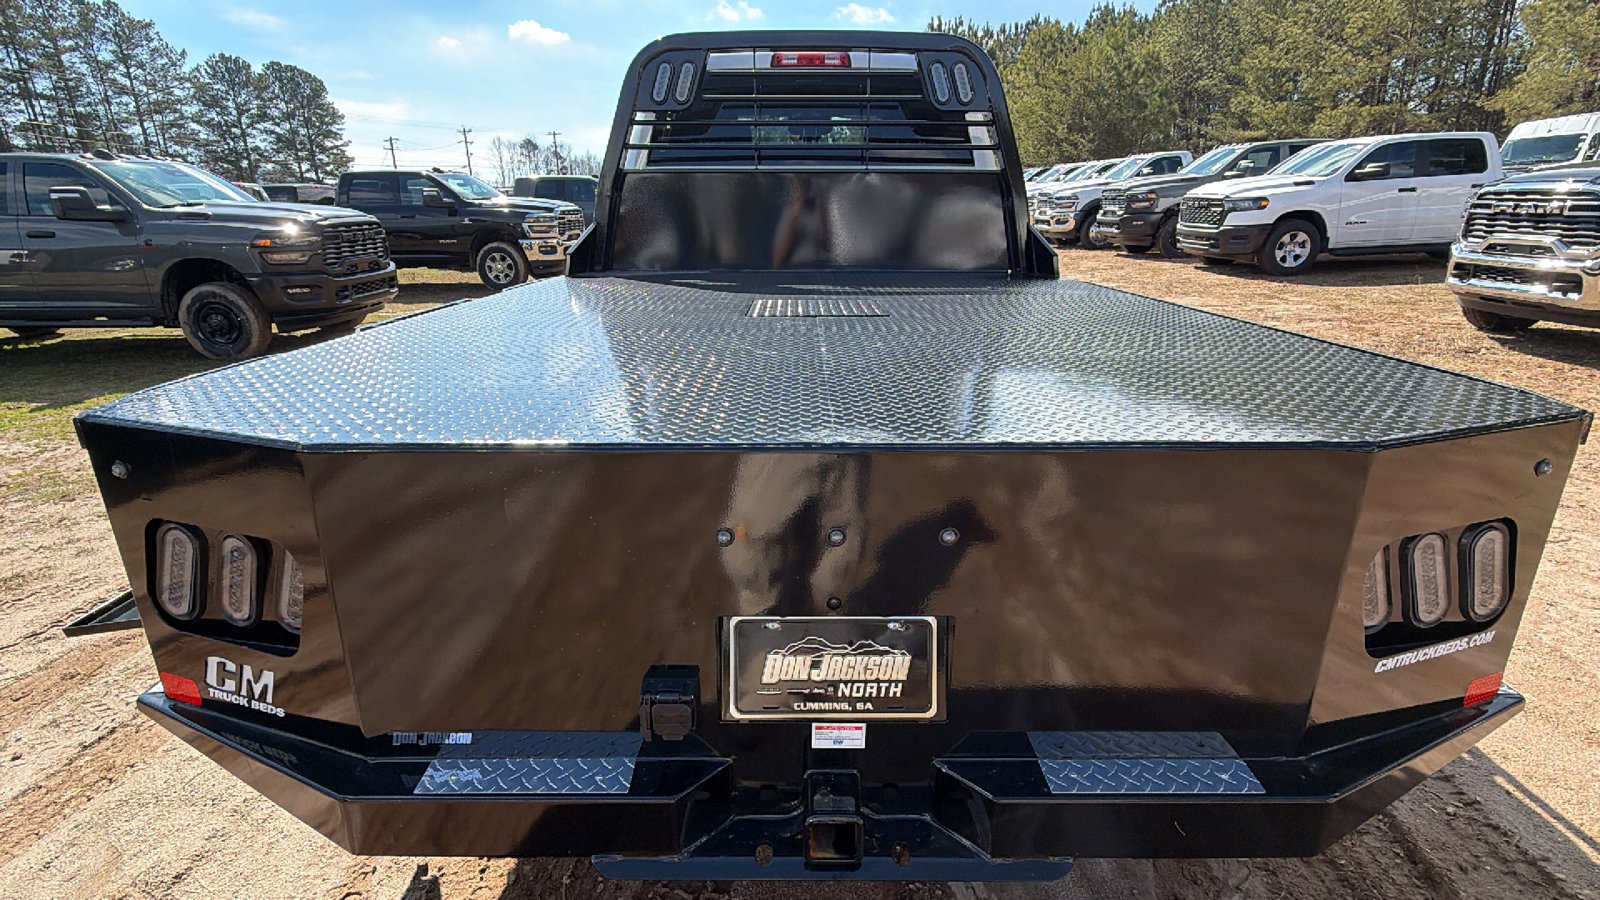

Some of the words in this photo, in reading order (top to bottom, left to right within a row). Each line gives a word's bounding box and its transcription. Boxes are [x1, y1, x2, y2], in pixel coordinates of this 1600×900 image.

[1493, 201, 1564, 213] RAM
[1374, 630, 1497, 673] CMTRUCKBEDS.COM
[206, 656, 274, 703] CM
[837, 683, 902, 697] NORTH
[207, 688, 250, 707] TRUCK
[251, 700, 286, 717] BEDS
[793, 702, 852, 711] CUMMING,
[856, 702, 873, 710] GA
